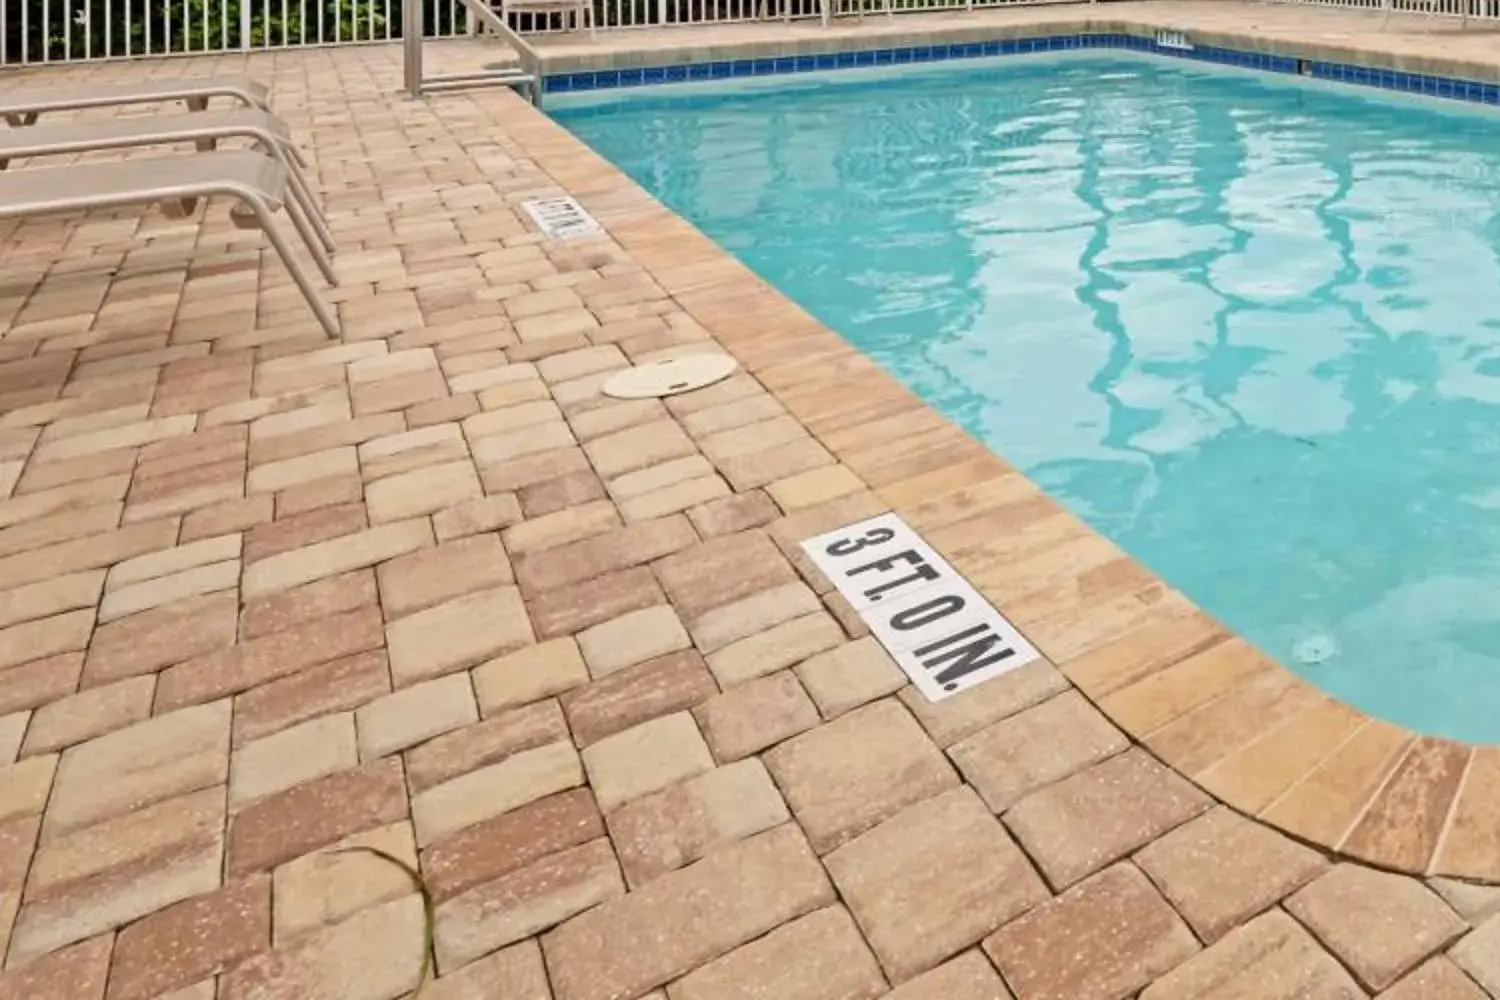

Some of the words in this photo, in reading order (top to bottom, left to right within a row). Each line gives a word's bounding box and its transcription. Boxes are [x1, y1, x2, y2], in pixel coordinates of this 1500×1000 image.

[826, 527, 895, 557] 3
[845, 549, 941, 602] FT.
[889, 595, 966, 631] 0
[913, 623, 1016, 691] IN.
